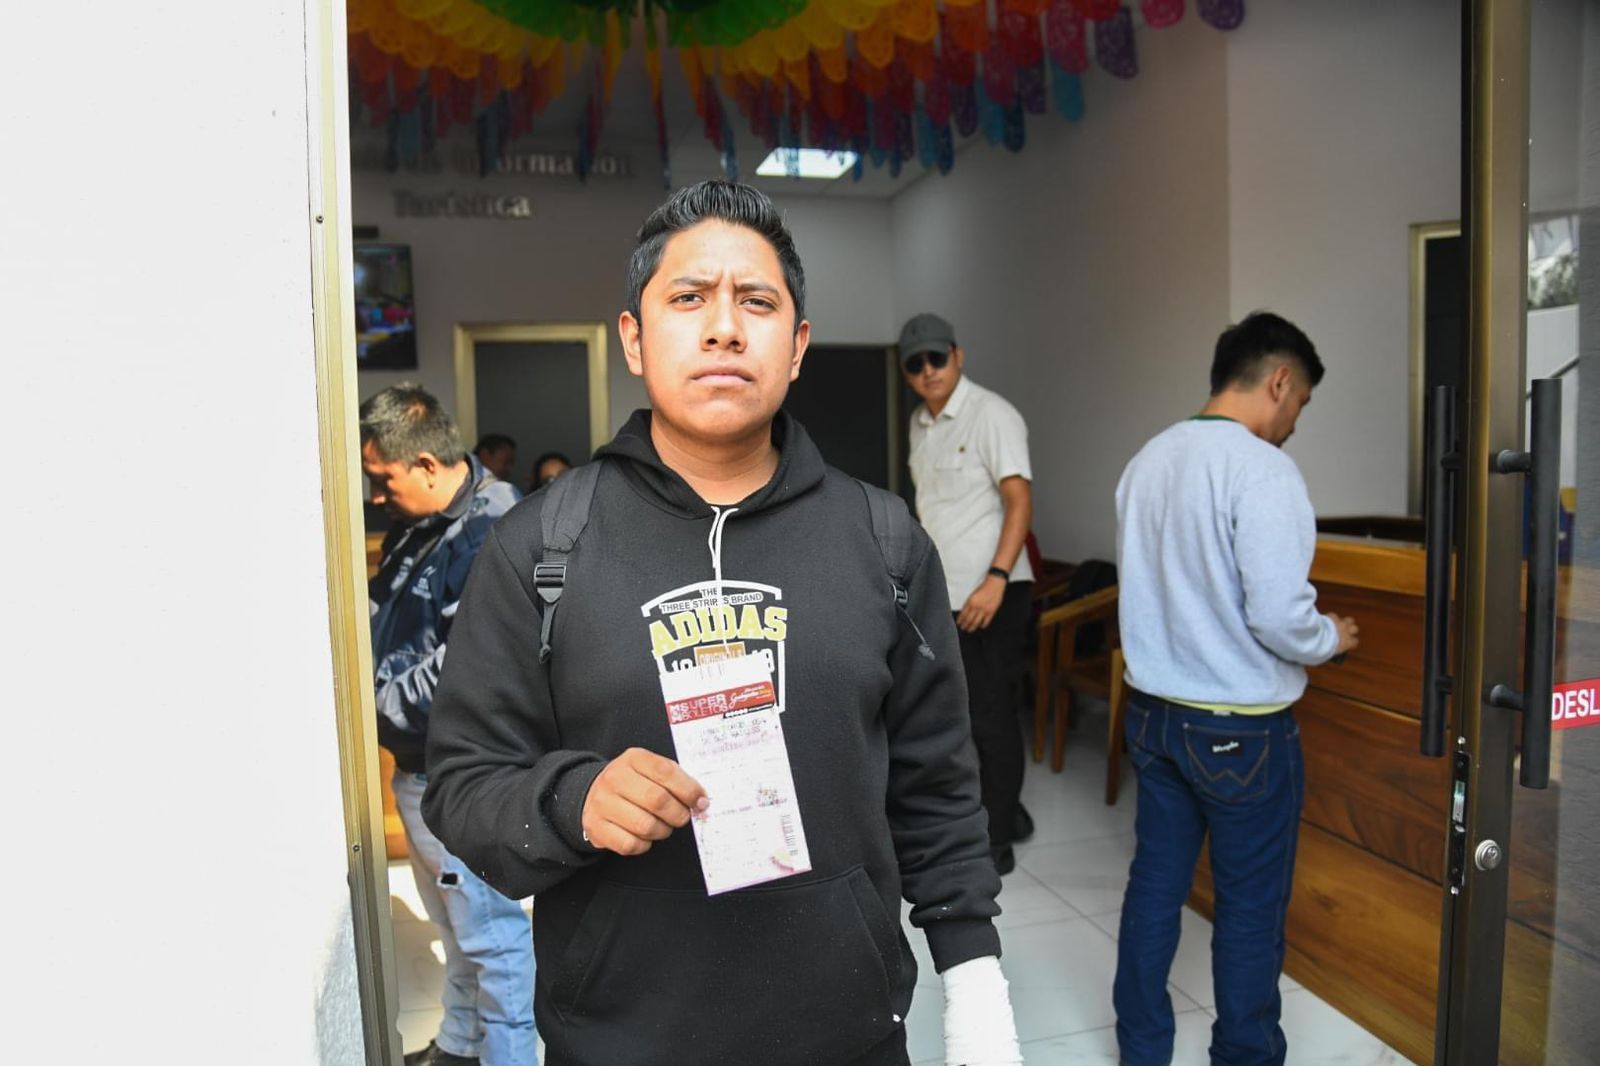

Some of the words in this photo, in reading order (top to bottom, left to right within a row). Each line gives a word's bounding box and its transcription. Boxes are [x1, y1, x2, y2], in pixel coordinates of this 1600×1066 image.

[661, 600, 691, 614] THREE
[692, 597, 730, 611] STRIPS
[731, 592, 763, 605] BRAND
[701, 587, 719, 598] THE
[649, 604, 788, 657] ADIDAS
